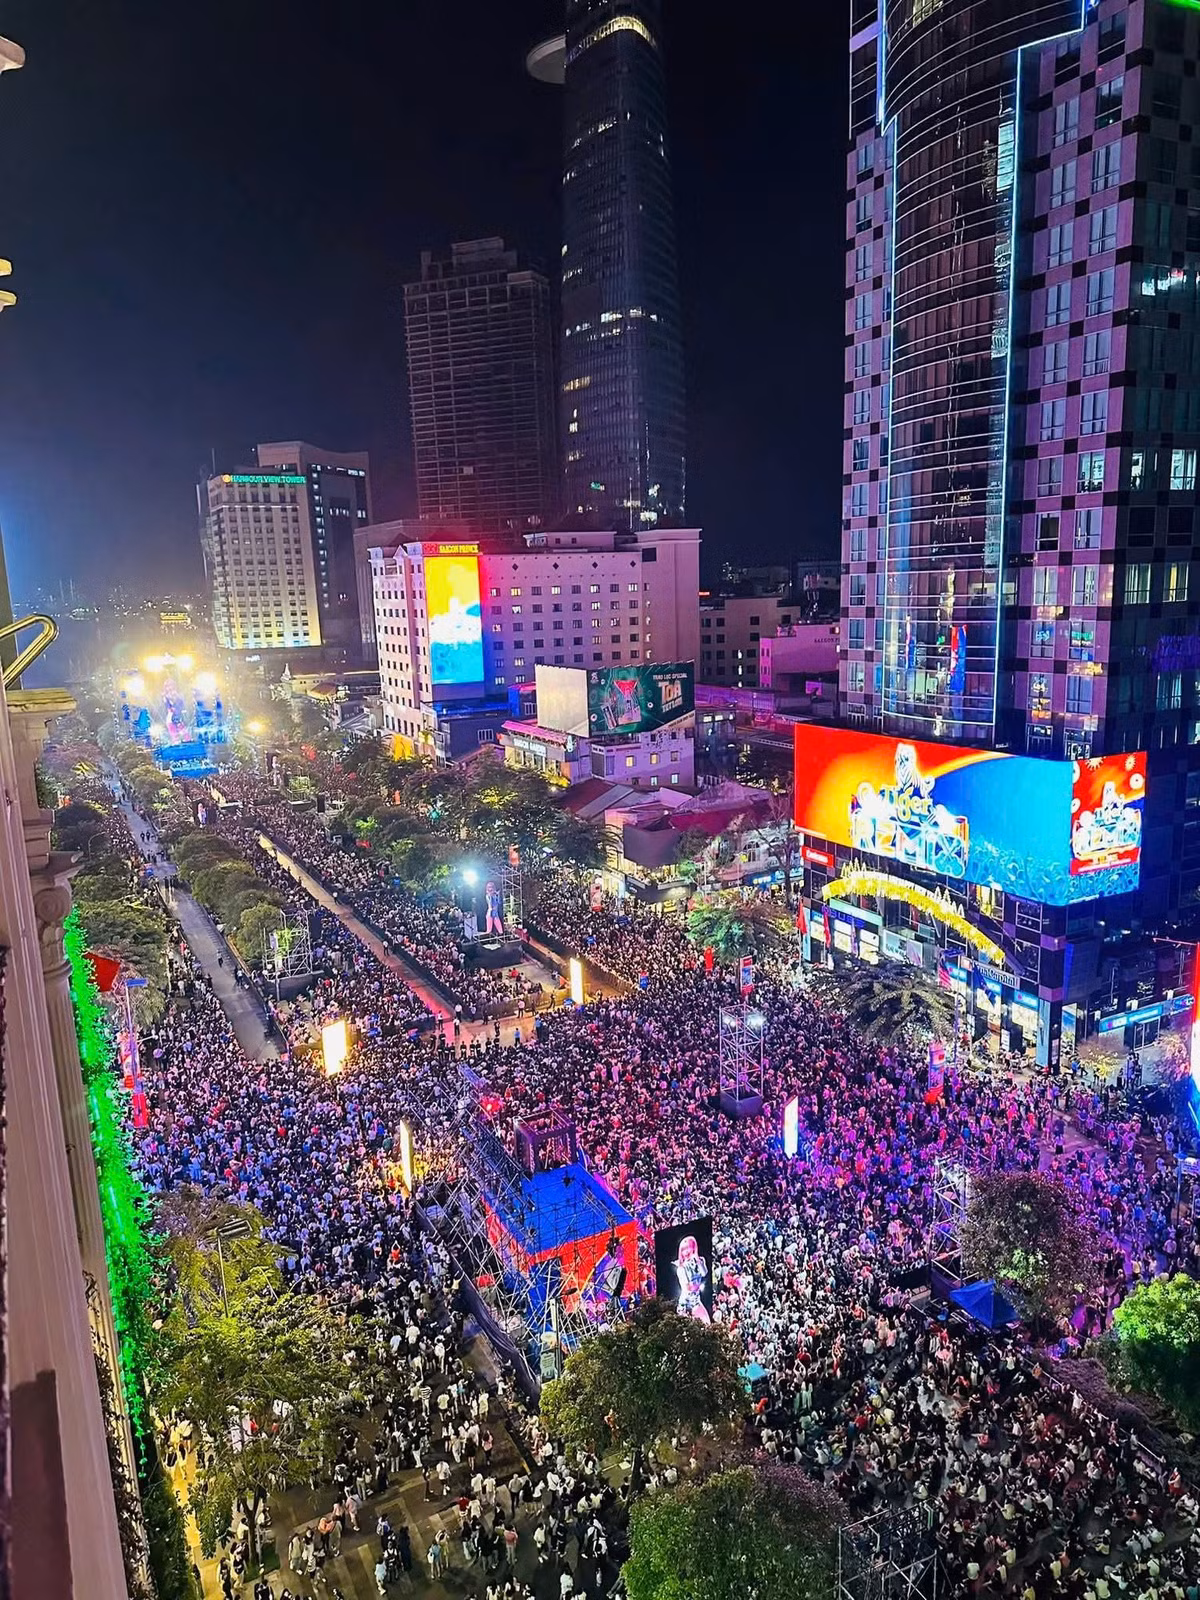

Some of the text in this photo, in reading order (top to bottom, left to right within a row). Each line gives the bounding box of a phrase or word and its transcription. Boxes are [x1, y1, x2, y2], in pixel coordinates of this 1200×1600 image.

[231, 475, 306, 484] HARBOUR VIEW TOWER
[880, 784, 933, 822] Tiger
